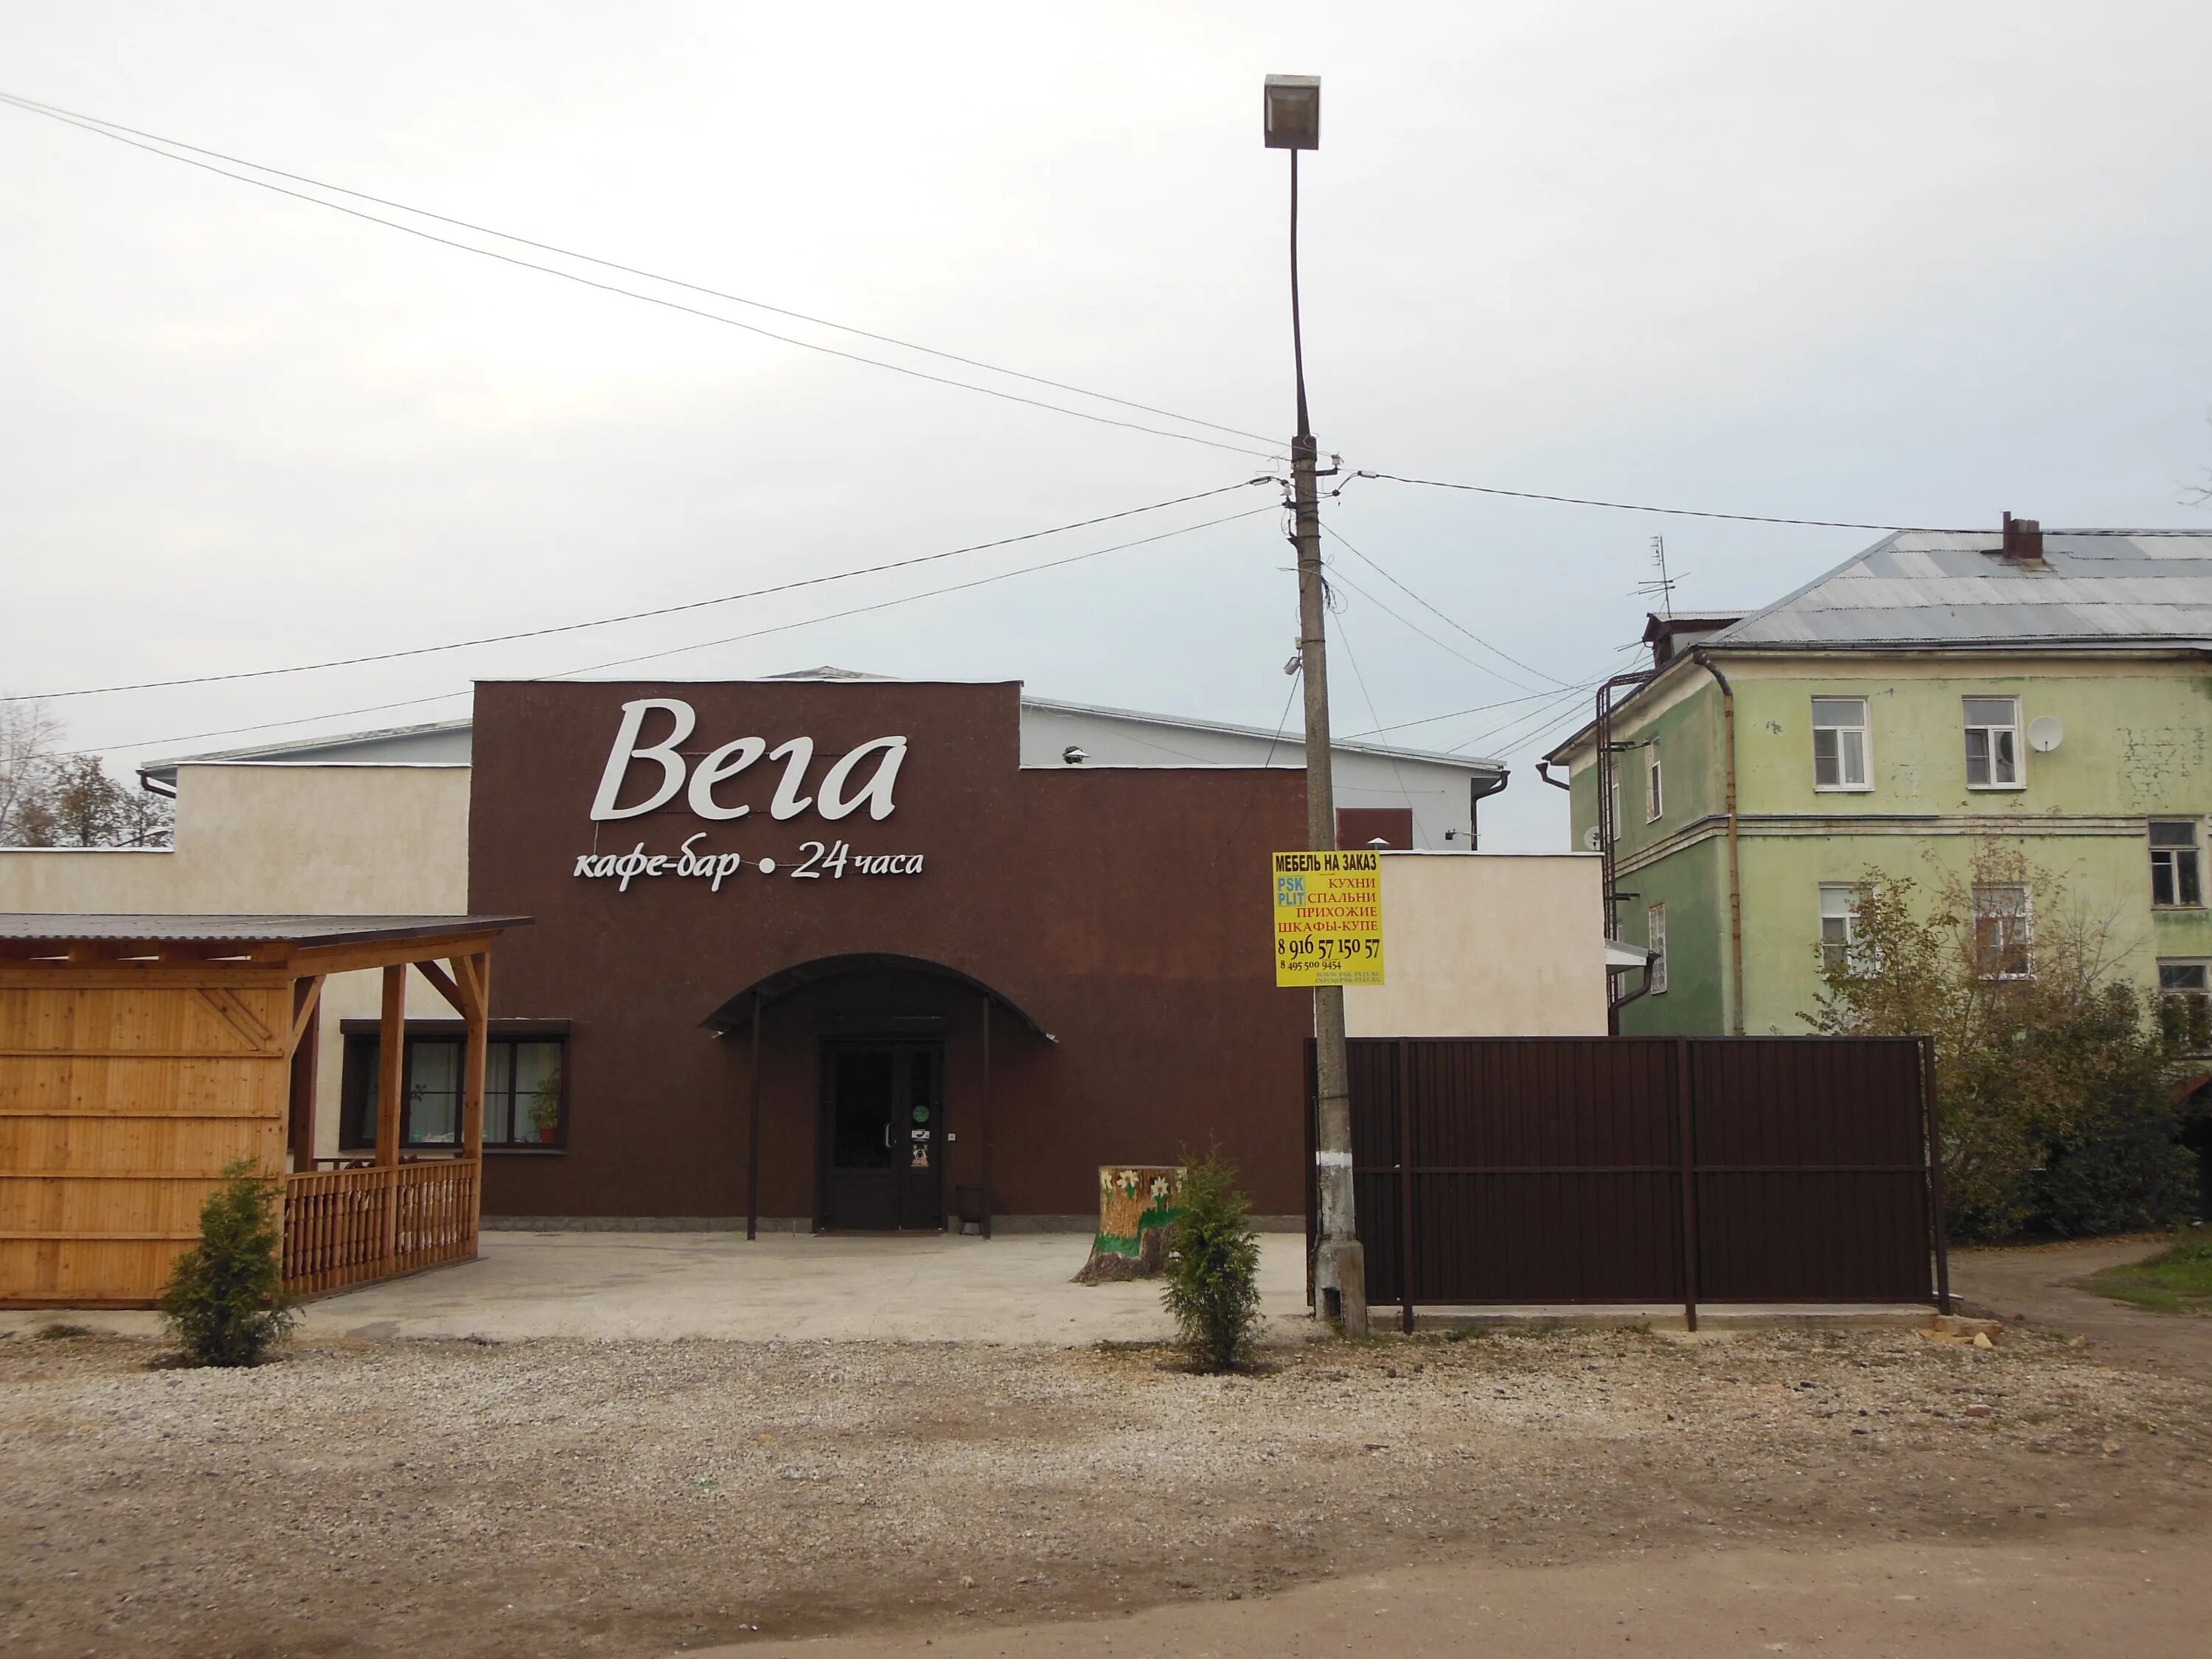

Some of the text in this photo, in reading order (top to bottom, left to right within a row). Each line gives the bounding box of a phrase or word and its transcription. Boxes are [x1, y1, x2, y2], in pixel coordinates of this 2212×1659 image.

[590, 698, 908, 821] Вега
[573, 832, 924, 892] кафе-бар 24 часа
[1276, 854, 1377, 872] МЕБЕЛЬ НА ЗАКАЗ
[1278, 877, 1304, 891] PSK
[1329, 878, 1375, 888] КУХНИ
[1278, 893, 1304, 905] PLIT
[1307, 892, 1376, 903] СПАЛЬНИ
[1296, 907, 1377, 918] ПРИХОЖИЕ
[1278, 920, 1378, 933] ШКАФЫ-КУПЕ
[1278, 933, 1380, 960] 8 916 57 150 57
[1280, 960, 1341, 971] 8 495 500 9454
